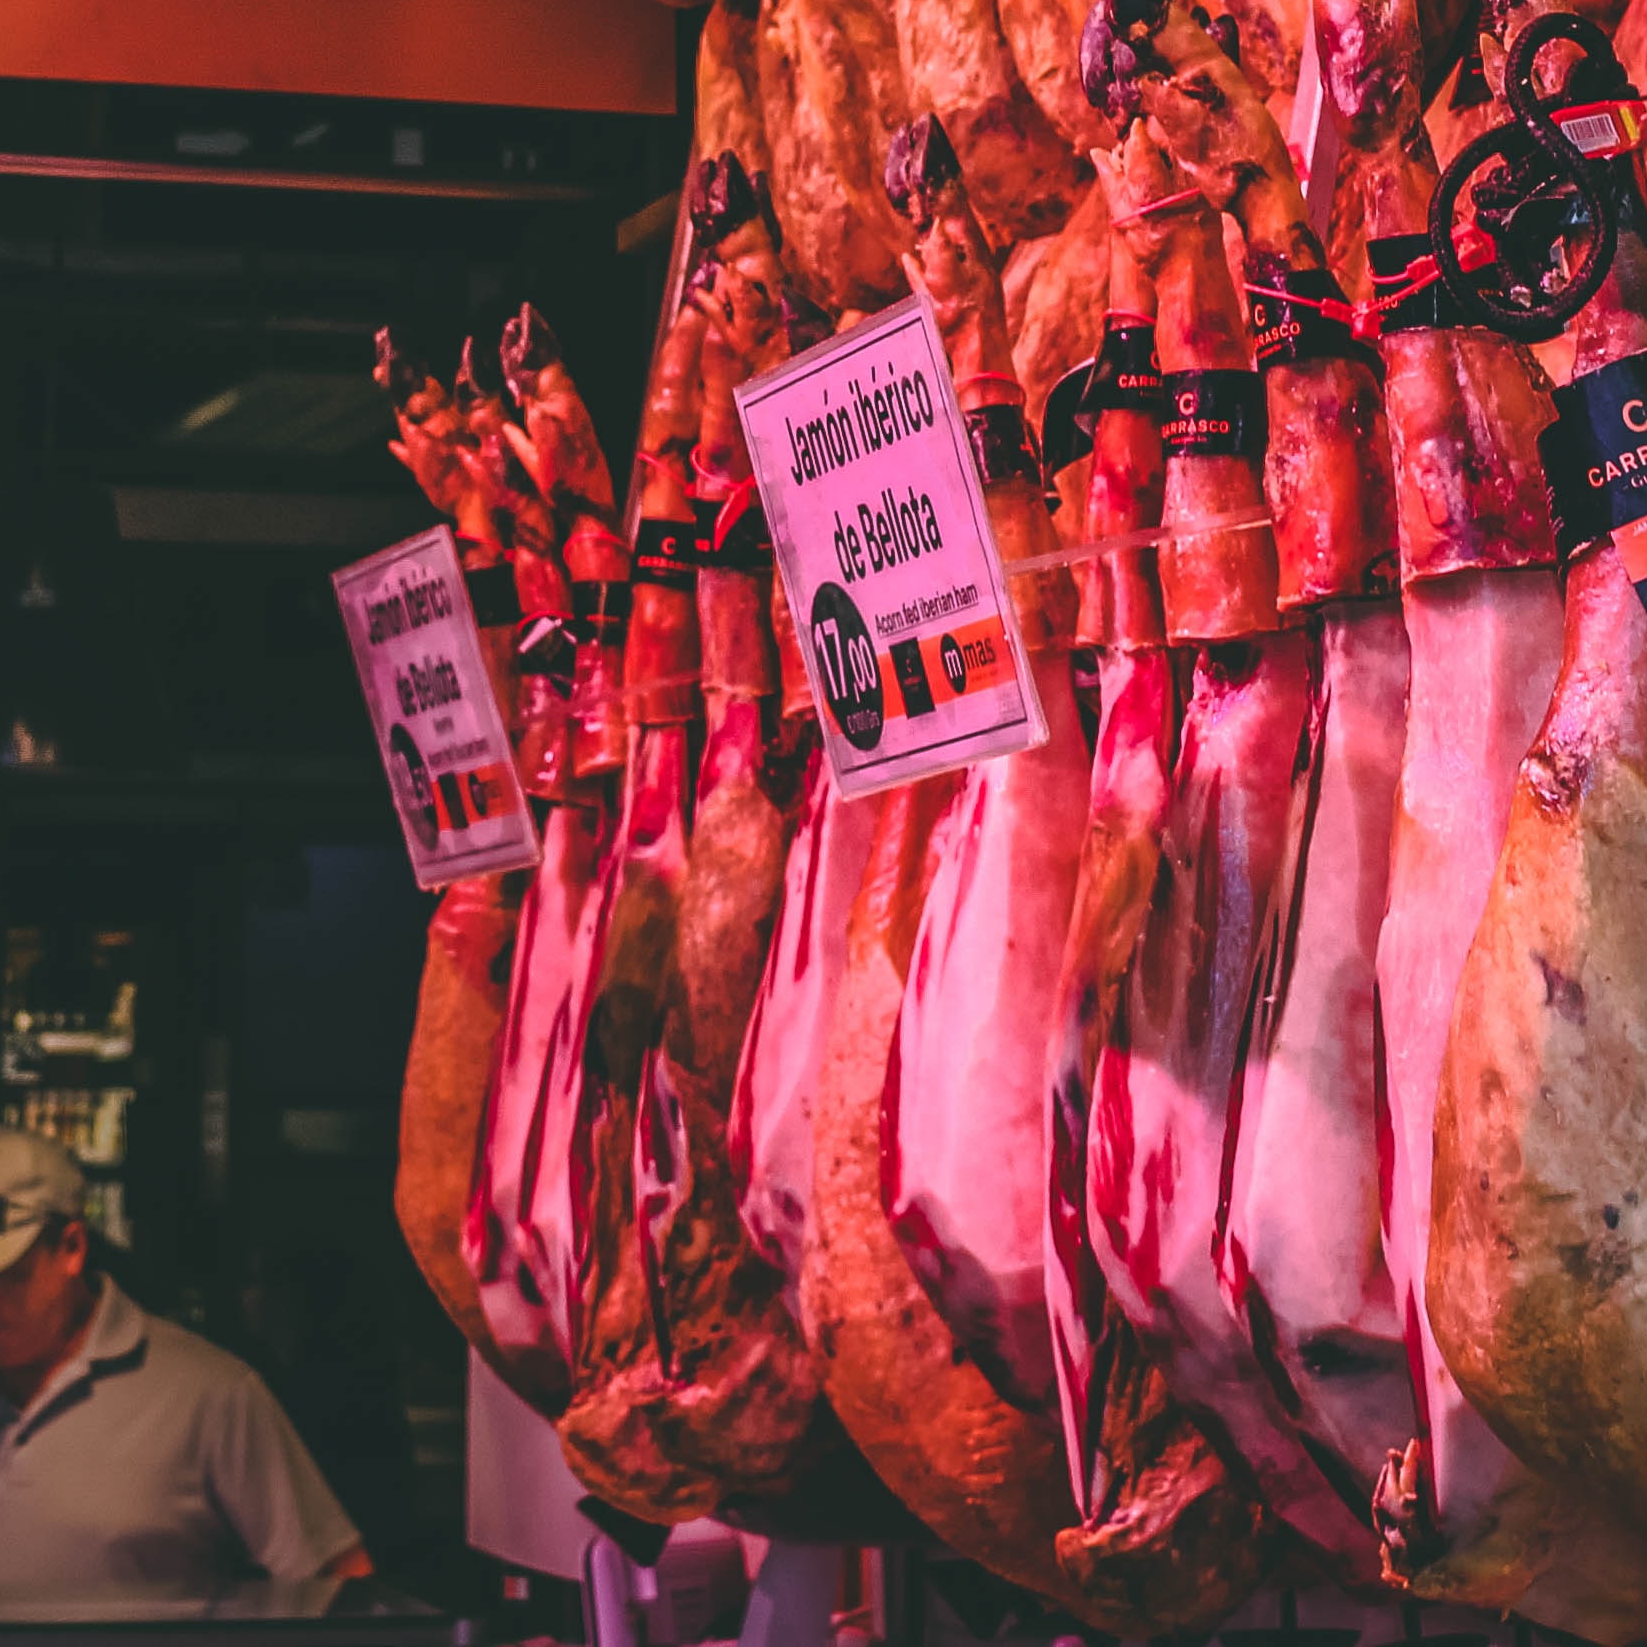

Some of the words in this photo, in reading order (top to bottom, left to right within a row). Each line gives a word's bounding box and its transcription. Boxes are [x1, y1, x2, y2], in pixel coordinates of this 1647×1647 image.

[1254, 321, 1300, 350] RASCO
[785, 388, 860, 486] Jamón
[849, 361, 934, 455] ibérico
[1162, 419, 1229, 438] ARRASCO
[833, 510, 866, 584] de
[857, 486, 943, 574] Bellota
[874, 613, 904, 635] Acorn
[903, 601, 920, 625] fed
[919, 591, 954, 617] iberian
[953, 583, 979, 606] ham
[815, 618, 878, 704] 17,00
[963, 638, 996, 671] mas
